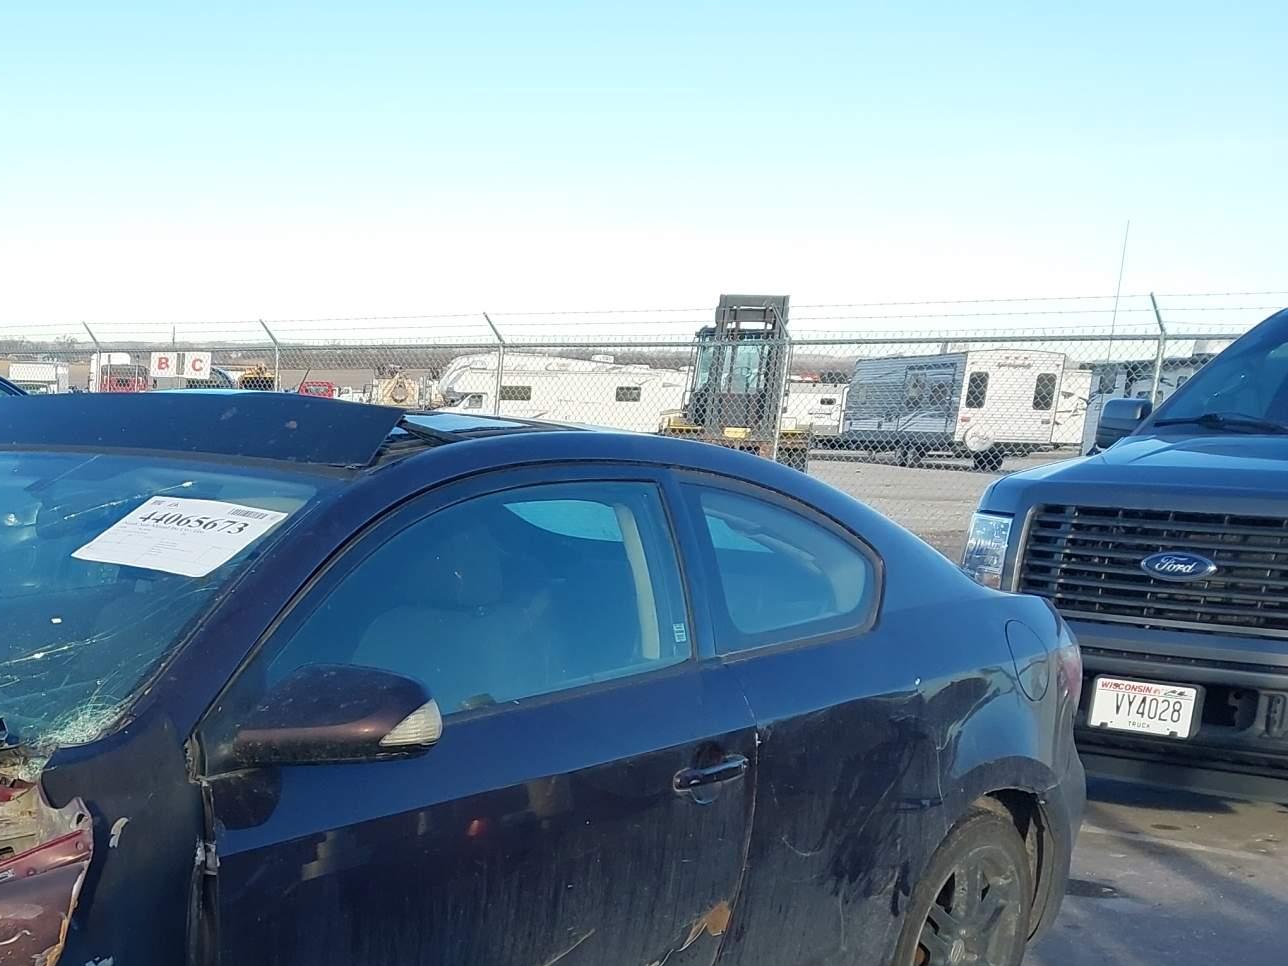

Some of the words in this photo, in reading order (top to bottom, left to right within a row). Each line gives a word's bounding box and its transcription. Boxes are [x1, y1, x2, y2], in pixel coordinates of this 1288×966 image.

[158, 356, 169, 370] B
[192, 358, 204, 372] C
[139, 510, 249, 535] 44065673
[1154, 555, 1198, 573] Ford
[1101, 680, 1152, 694] WISCONSIN
[1115, 693, 1182, 723] VY4028
[1128, 720, 1150, 728] TRUCK
